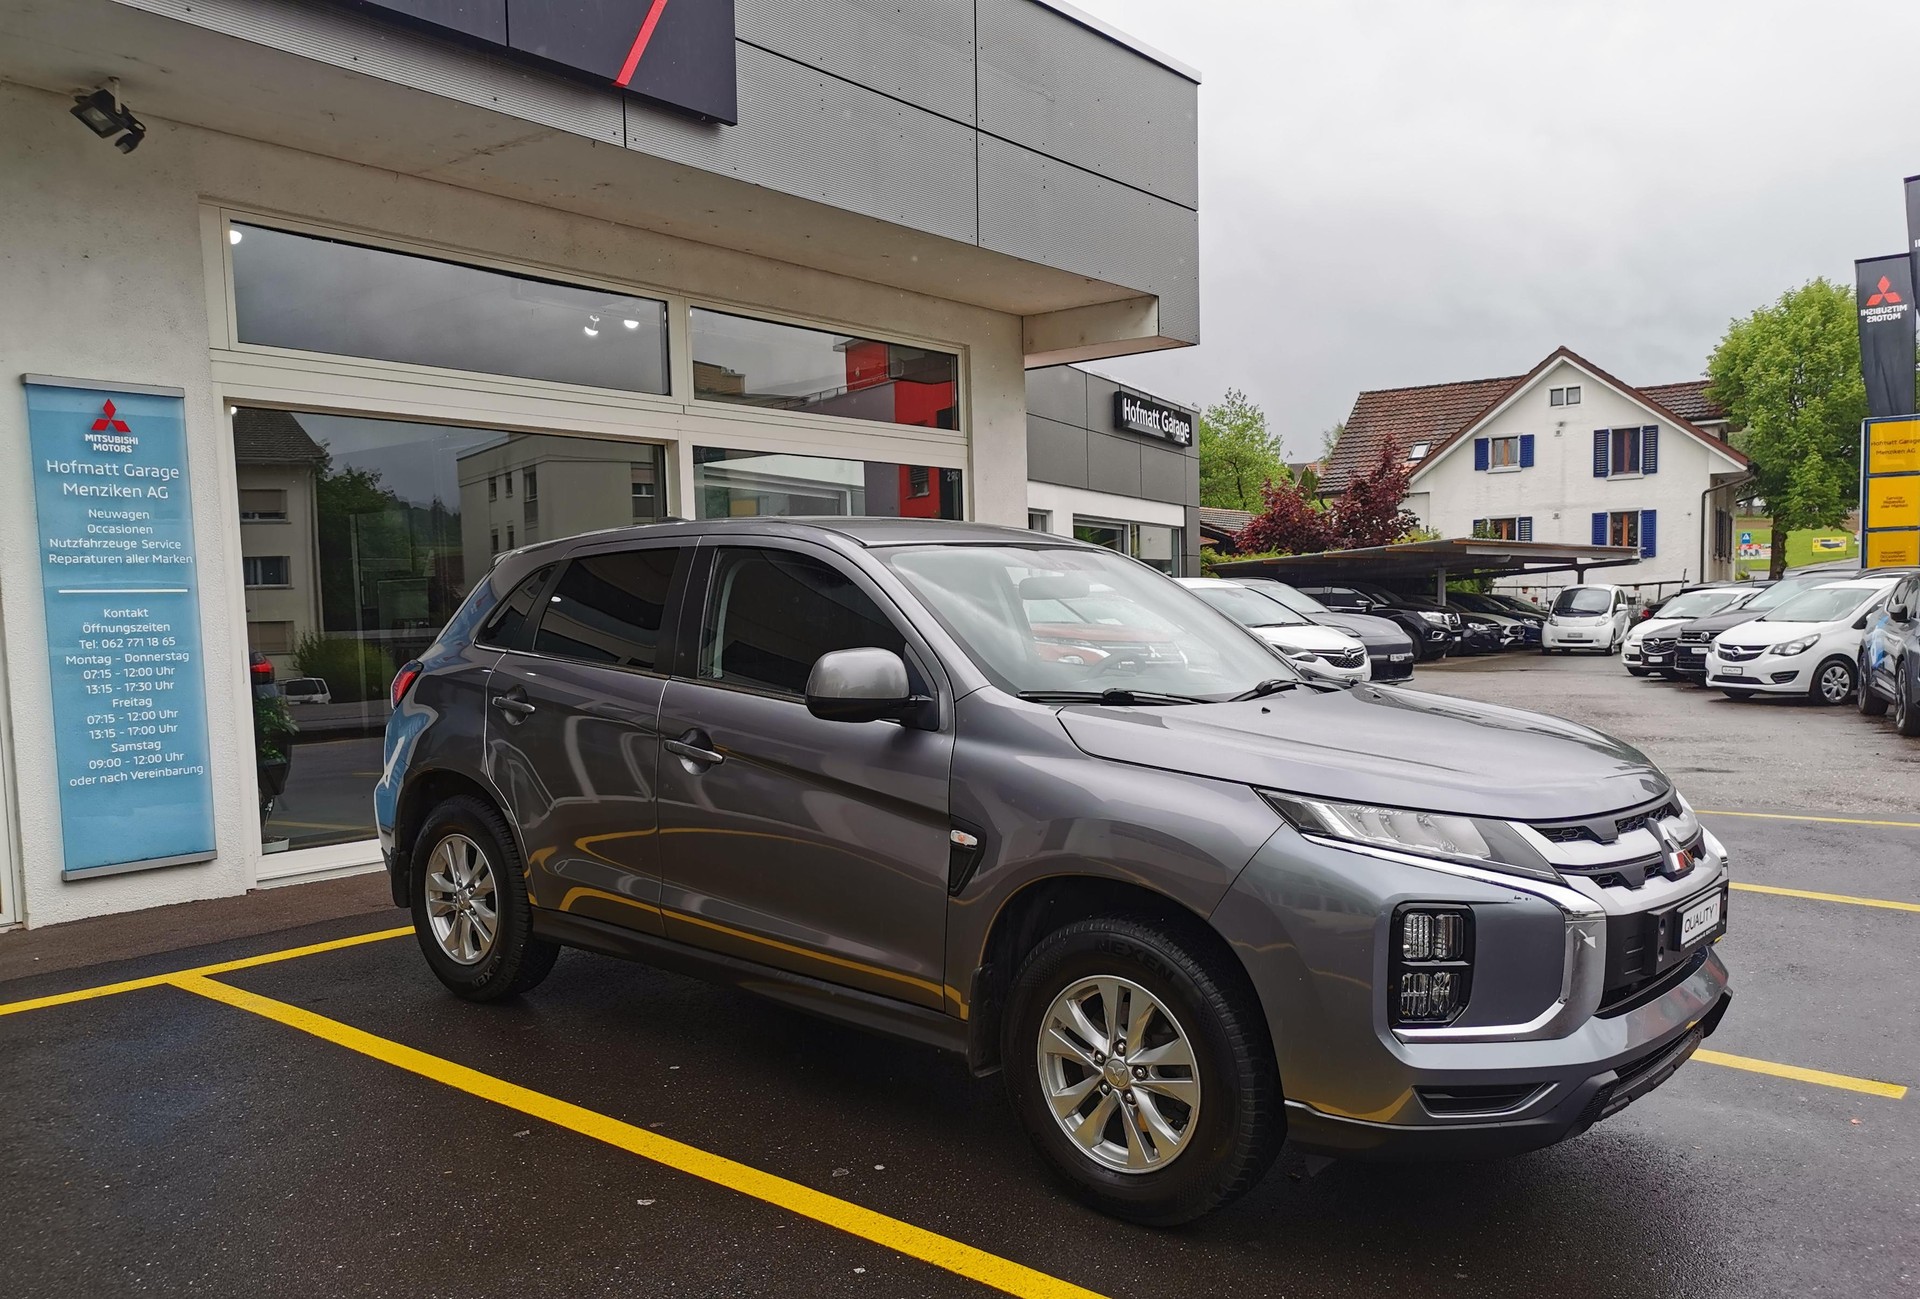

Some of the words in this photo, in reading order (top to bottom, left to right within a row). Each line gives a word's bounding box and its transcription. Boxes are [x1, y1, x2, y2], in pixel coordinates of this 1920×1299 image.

[1123, 398, 1160, 430] Hofmatt
[1161, 410, 1190, 442] Garage
[85, 433, 139, 445] MITSUBISHI
[93, 443, 132, 453] MOTORS
[46, 460, 120, 477] Hofmatt
[123, 463, 180, 482] Garage
[63, 482, 142, 499] Menziken
[146, 486, 169, 499] AG
[88, 508, 150, 522] Neuwagen
[87, 524, 153, 535] Occasionen
[50, 538, 138, 551] Nutzfahrzeuge
[141, 539, 182, 550] Service
[49, 553, 122, 566] Reparaturen
[125, 553, 150, 564] aller
[152, 553, 193, 564] Marken
[103, 608, 149, 618] Kontakt
[82, 622, 171, 635] Öffnungszeiten
[79, 639, 99, 650] Tel:
[101, 638, 124, 649] 062
[126, 638, 145, 648] 771
[147, 637, 159, 647] 18
[162, 636, 176, 646] 65
[65, 655, 112, 666] Montag
[124, 651, 190, 664] Donnerstag
[83, 669, 112, 680] 07:15
[123, 667, 153, 678] 12:00
[155, 666, 175, 676] Uhr
[86, 683, 113, 695] 13:15
[124, 682, 152, 692] 17:30
[155, 680, 175, 691] Uhr
[112, 697, 153, 708] Freitag
[86, 714, 115, 725] 07:15
[127, 711, 156, 721] 12:00
[159, 709, 179, 719] Uhr
[88, 728, 116, 740] 13:15
[127, 725, 156, 736] 17:00
[159, 724, 179, 734] Uhr
[111, 740, 162, 753] Samstag
[88, 758, 122, 770] 09:00
[133, 754, 163, 765] 12:00
[165, 752, 185, 762] Uhr
[70, 776, 97, 787] oder
[100, 772, 128, 784] nach
[130, 765, 204, 780] Vereinbarung
[1096, 940, 1175, 982] NEXEN
